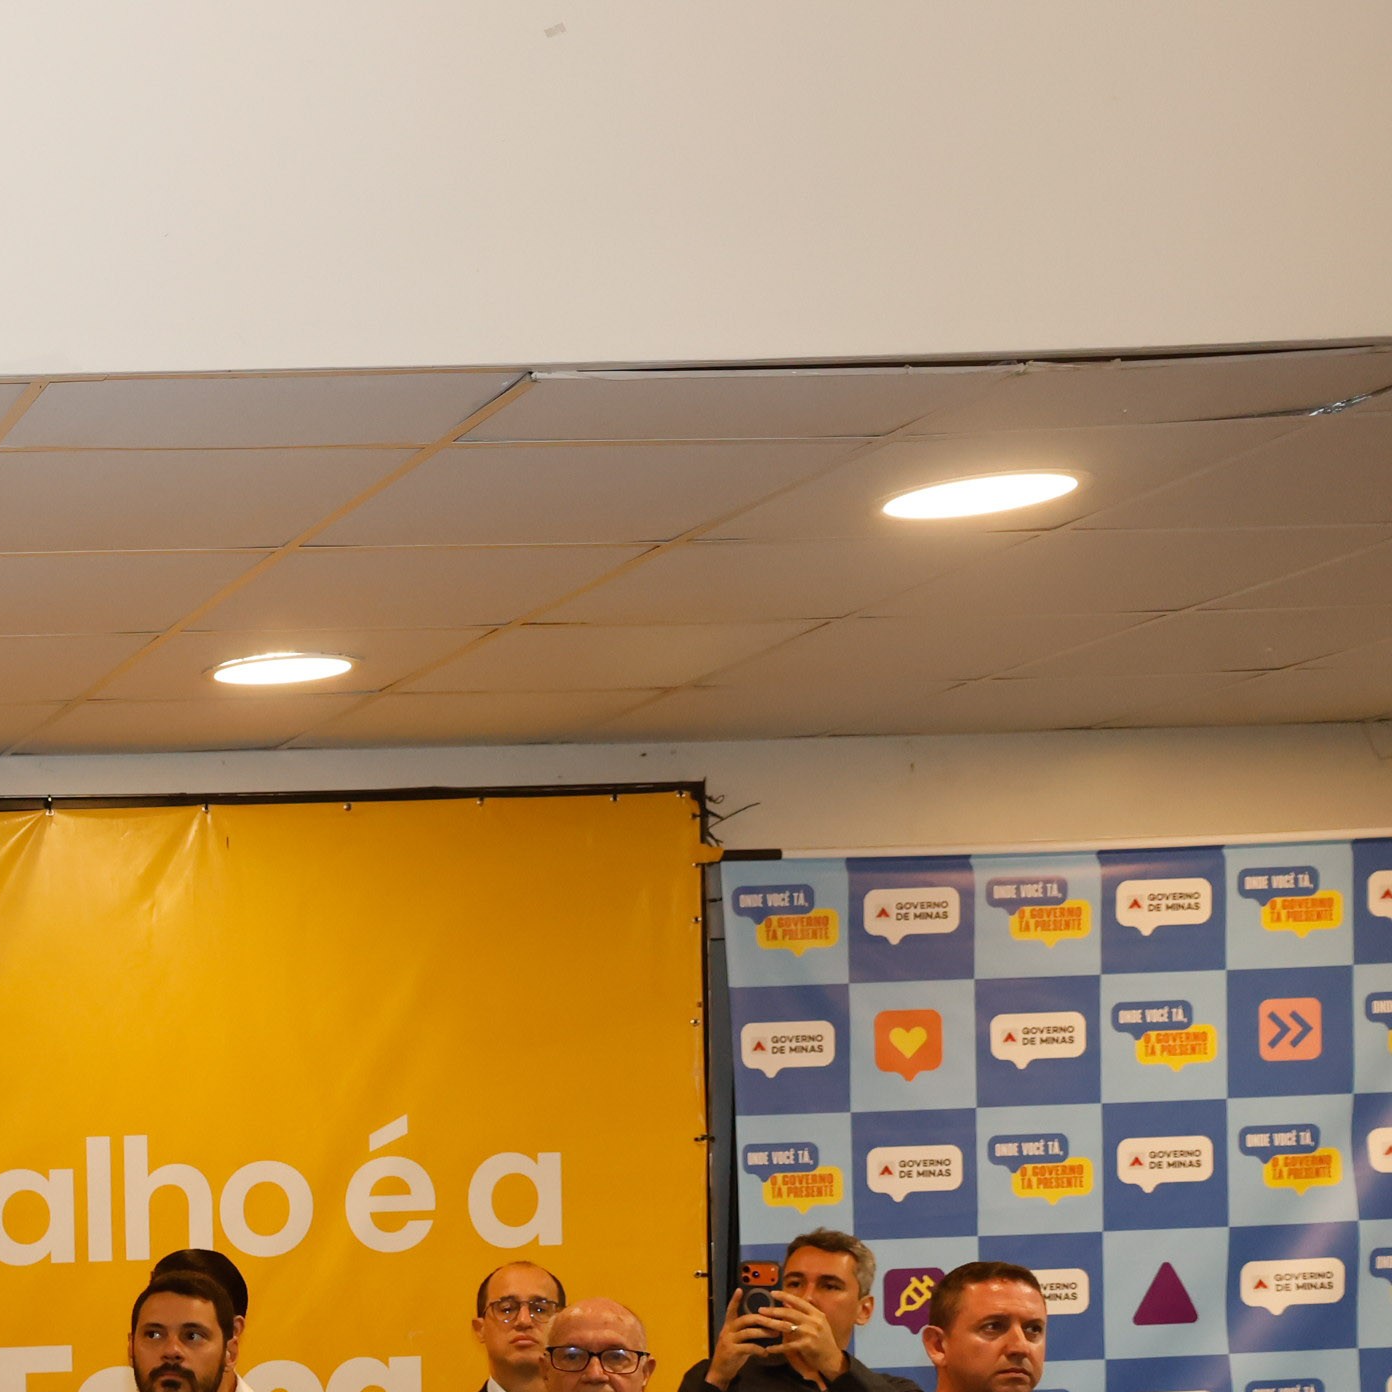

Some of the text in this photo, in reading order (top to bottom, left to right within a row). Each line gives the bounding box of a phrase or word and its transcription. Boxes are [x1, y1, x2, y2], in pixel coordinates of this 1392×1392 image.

[1147, 891, 1201, 901] GOVERNO
[895, 901, 949, 910] GOVERNO
[1148, 902, 1200, 912] DE MINAS
[896, 911, 949, 921] DE MINAS
[1022, 1025, 1075, 1035] GOVERNO
[771, 1034, 824, 1044] GOVERNO
[1022, 1035, 1075, 1046] DE MINAS
[771, 1044, 824, 1055] DE MINAS
[1149, 1149, 1202, 1159] GOVERNO
[899, 1158, 951, 1168] GOVERNO
[1149, 1159, 1202, 1170] DE MINAS
[899, 1168, 951, 1179] DE MINAS
[345, 1114, 436, 1250] é
[468, 1150, 563, 1249] a
[1274, 1271, 1334, 1282] GOVERNO
[1040, 1282, 1078, 1291] VERNO
[1275, 1281, 1334, 1292] DE MINAS
